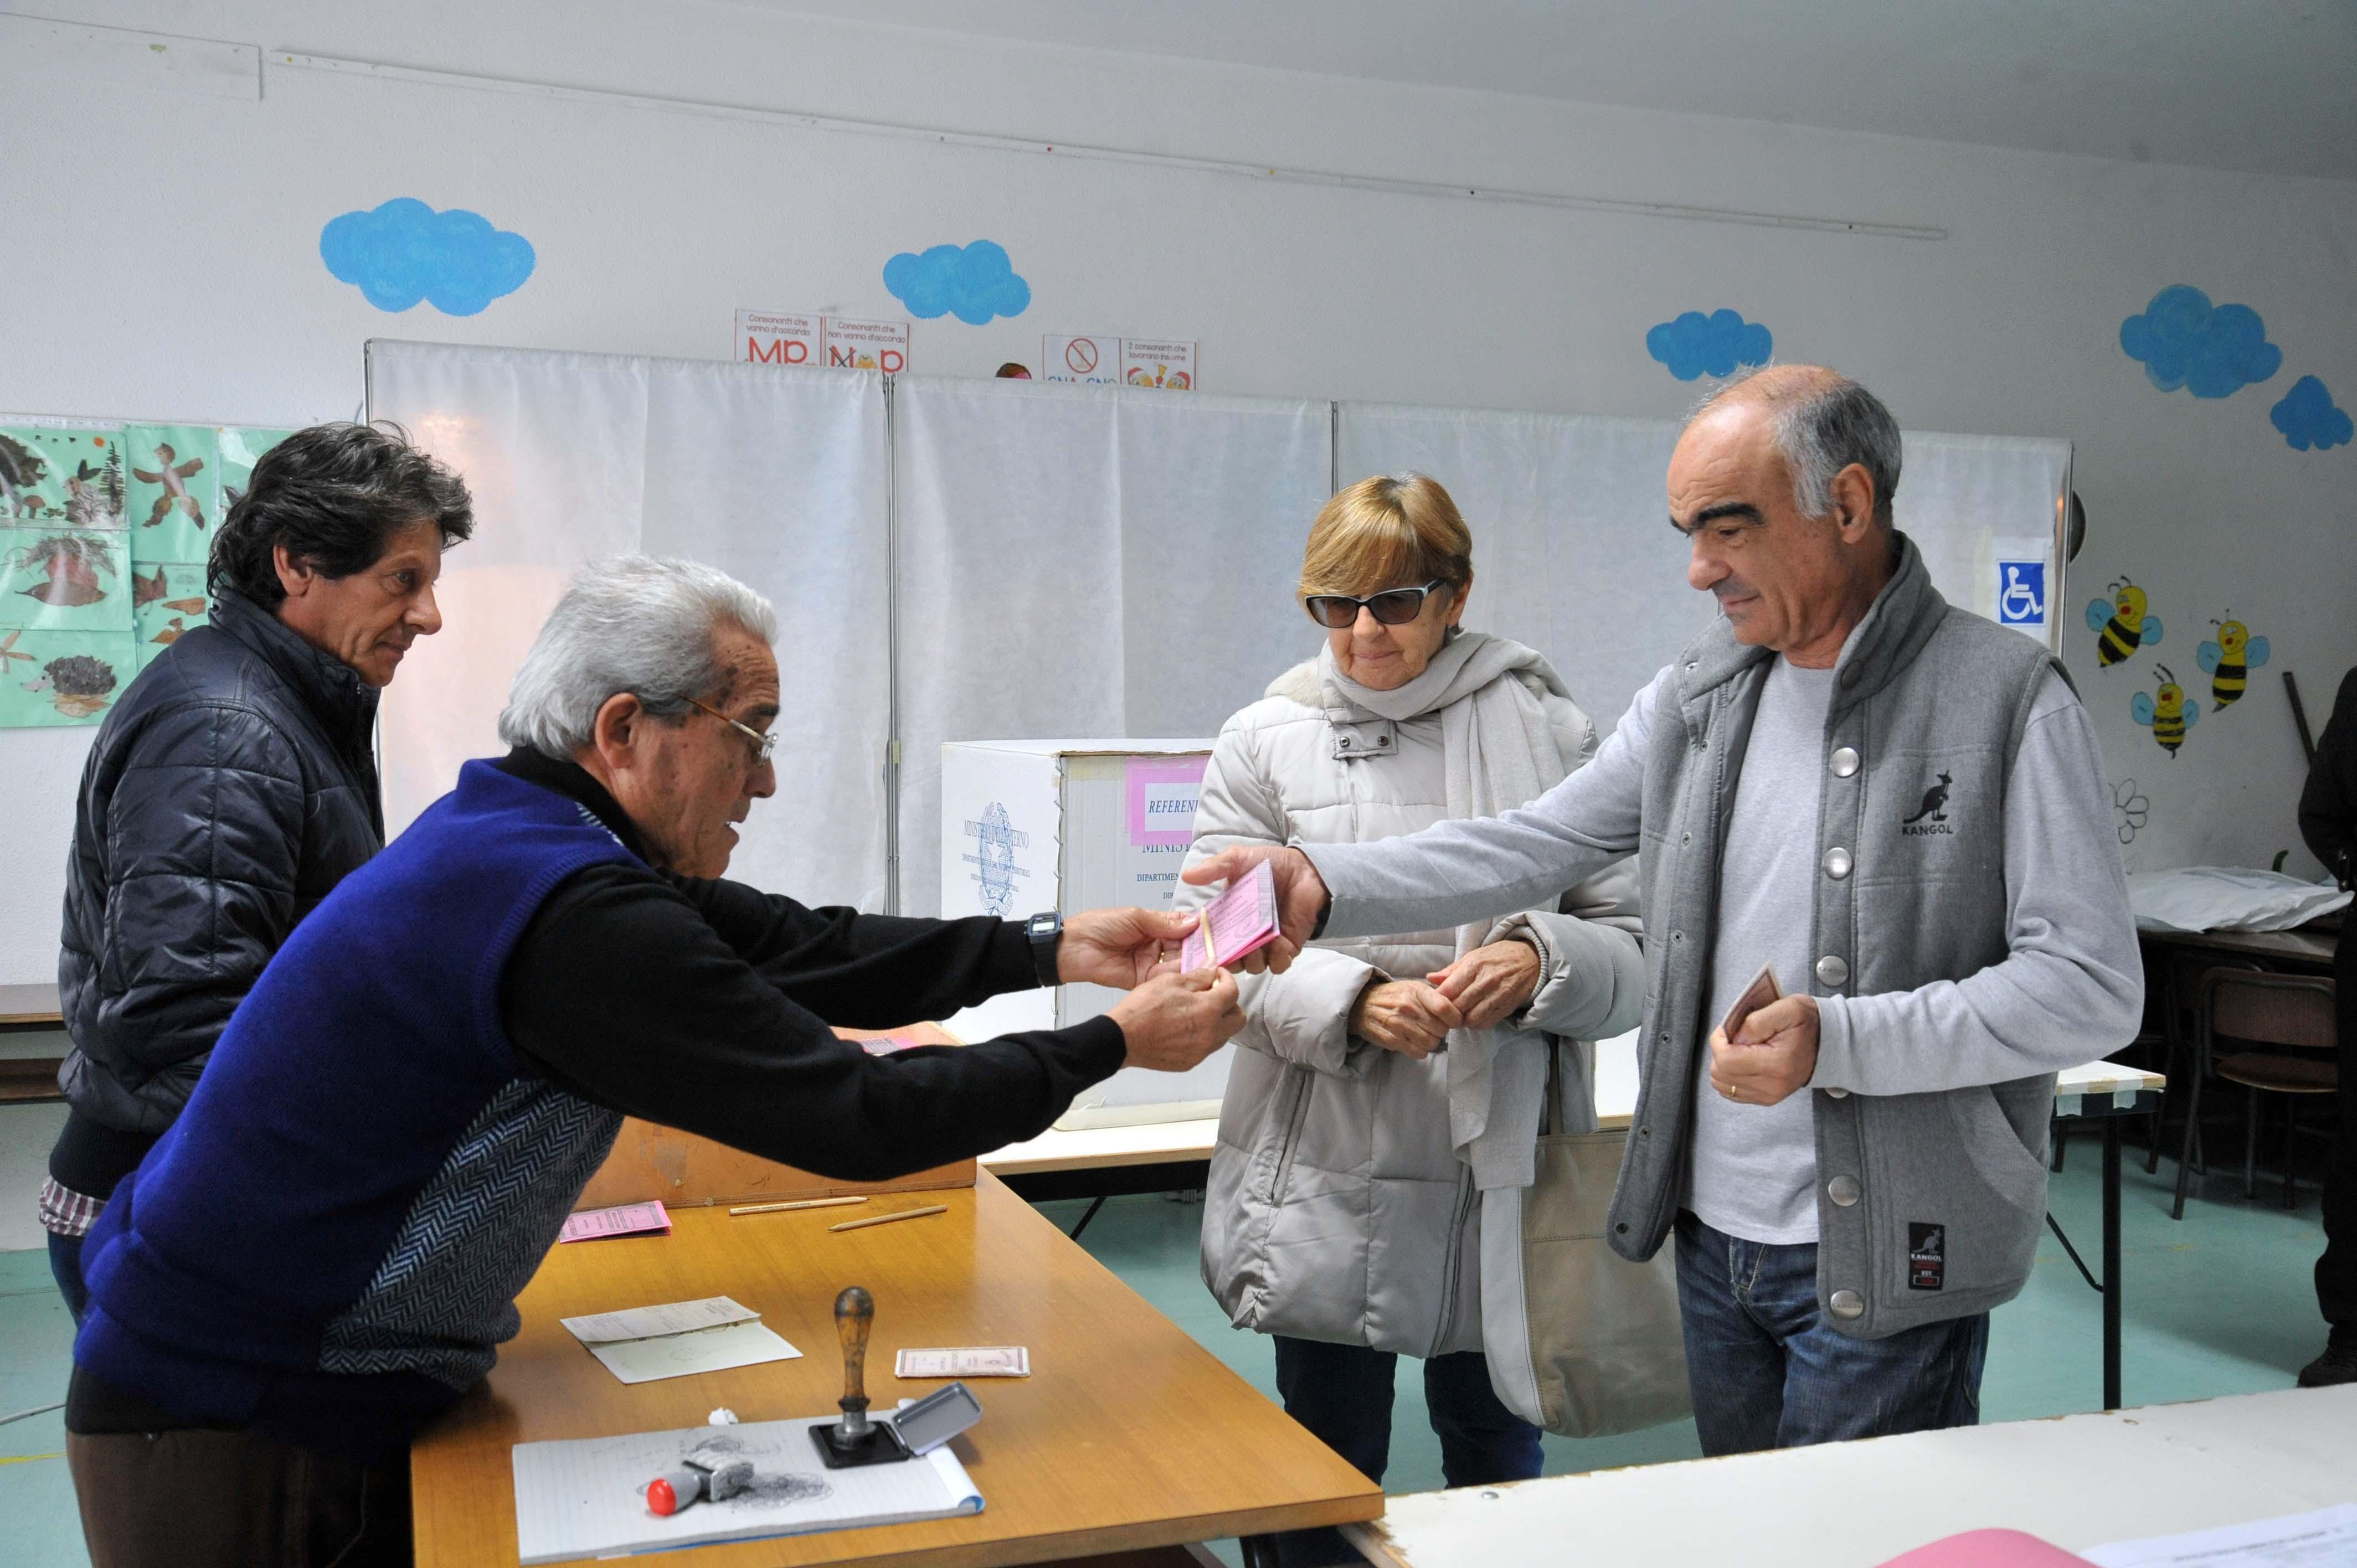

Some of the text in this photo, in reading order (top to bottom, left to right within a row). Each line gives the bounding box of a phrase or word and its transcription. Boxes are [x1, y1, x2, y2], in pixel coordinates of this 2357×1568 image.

[749, 314, 792, 325] Consonanti
[771, 326, 811, 336] d'accordo
[838, 322, 881, 332] Consonanti
[868, 333, 905, 343] d'accordo
[1129, 351, 1160, 360] lavorano
[1902, 824, 1953, 837] KANGOL
[1911, 1253, 1942, 1262] KANGOL
